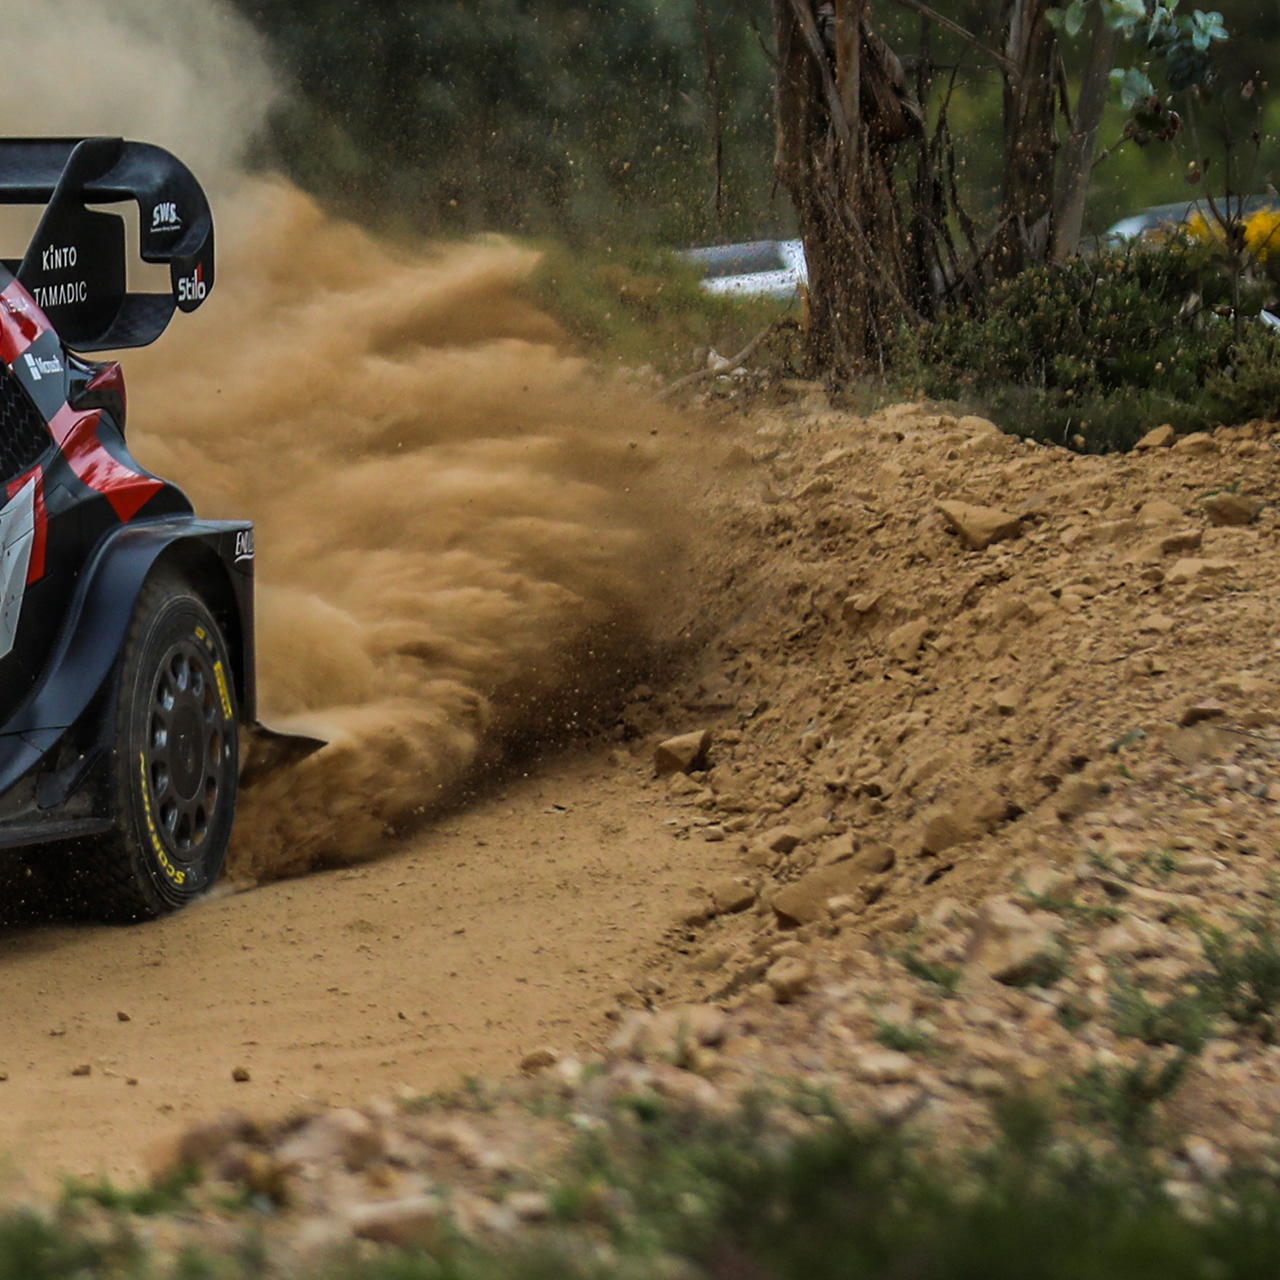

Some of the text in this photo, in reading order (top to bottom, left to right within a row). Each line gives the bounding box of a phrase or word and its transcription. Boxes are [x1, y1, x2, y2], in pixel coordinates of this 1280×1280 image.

[152, 202, 181, 227] SWS
[33, 281, 88, 308] TAMADIC
[177, 267, 206, 302] Stilo
